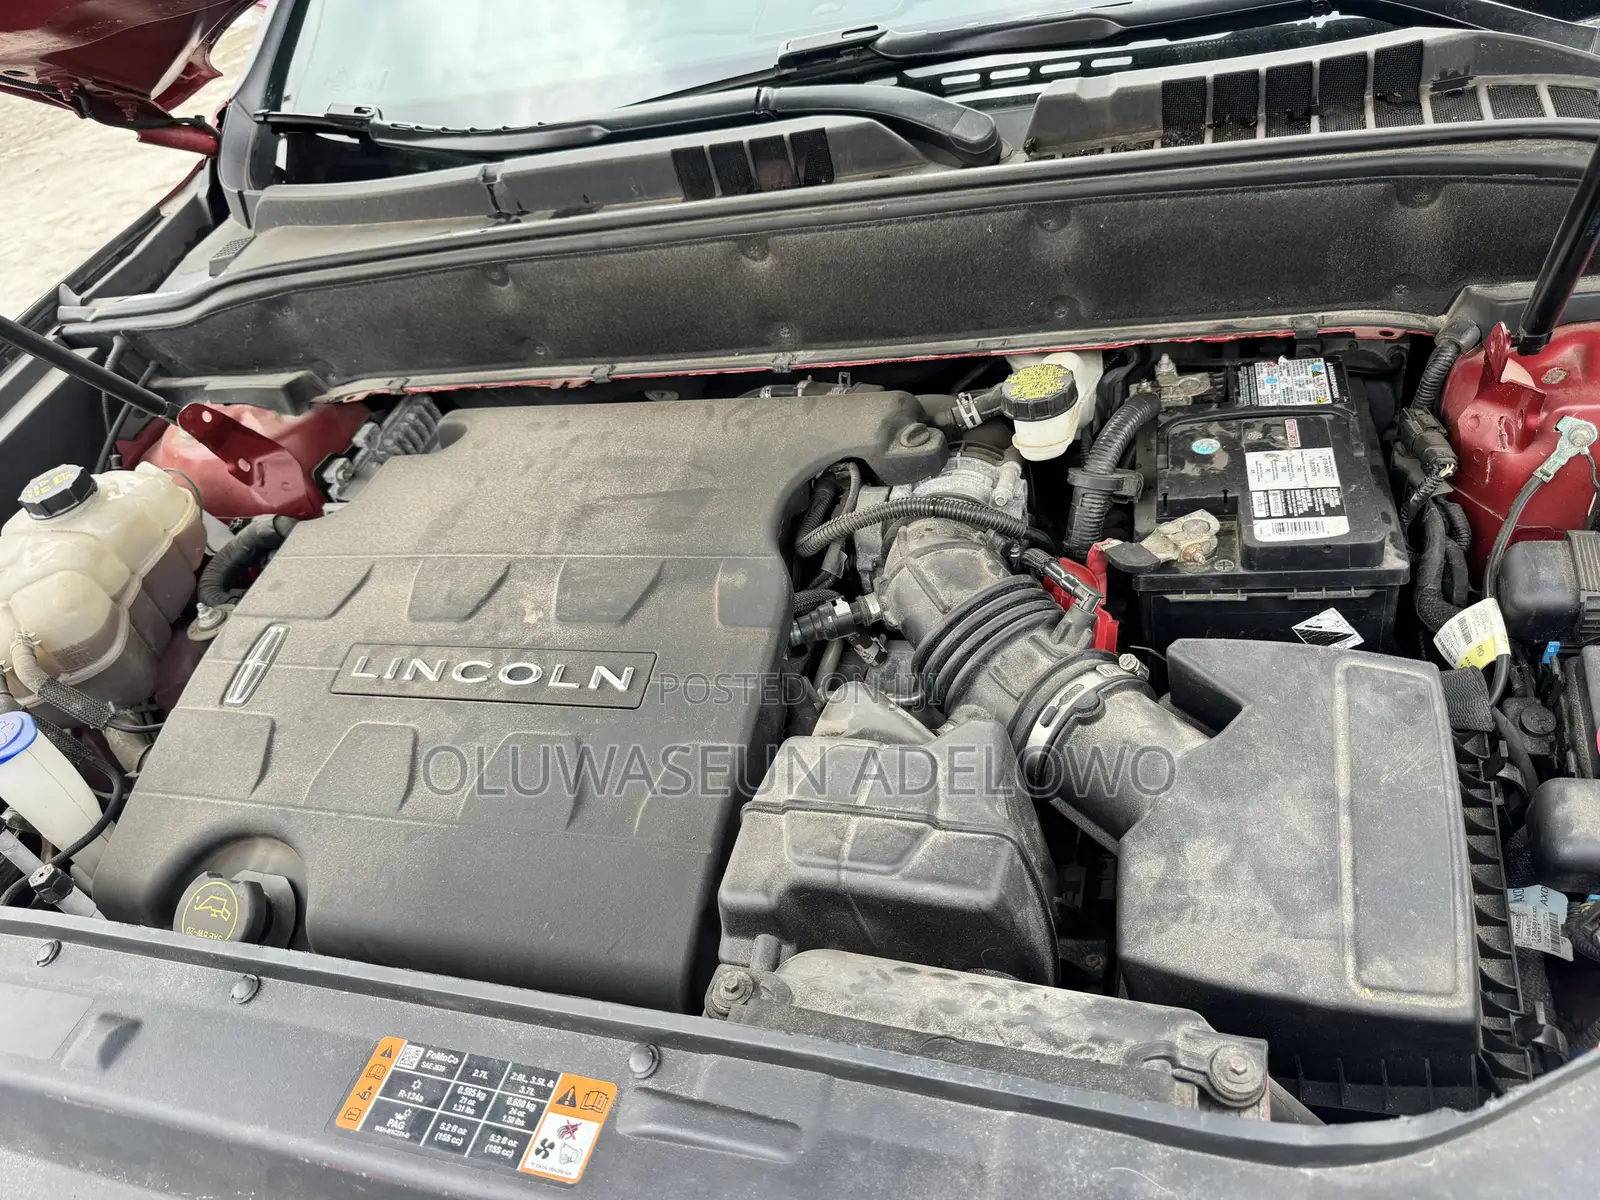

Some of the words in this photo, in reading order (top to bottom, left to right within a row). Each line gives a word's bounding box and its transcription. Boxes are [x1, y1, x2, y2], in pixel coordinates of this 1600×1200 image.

[350, 655, 635, 692] LINCOLN
[1540, 886, 1549, 906] AXD
[426, 1050, 459, 1065] FoMoCo
[472, 1069, 488, 1080] 2.7L
[529, 1076, 546, 1087] 3.5L
[547, 1079, 555, 1088] &
[398, 1089, 424, 1103] R-134a
[476, 1089, 487, 1101] kg
[519, 1085, 535, 1096] 3.7L
[459, 1096, 467, 1104] 21
[464, 1106, 475, 1115] lbs
[508, 1107, 518, 1115] 24
[517, 1110, 526, 1118] oz
[526, 1101, 537, 1112] kg
[386, 1118, 406, 1130] PAG
[515, 1117, 525, 1126] lbs
[439, 1122, 452, 1132] 5.2
[457, 1127, 468, 1136] oz
[434, 1132, 451, 1143] (155
[451, 1136, 464, 1147] cc)
[489, 1133, 501, 1143] 5.2
[507, 1139, 519, 1147] oz
[484, 1143, 501, 1154] (155
[501, 1148, 514, 1158] cc)
